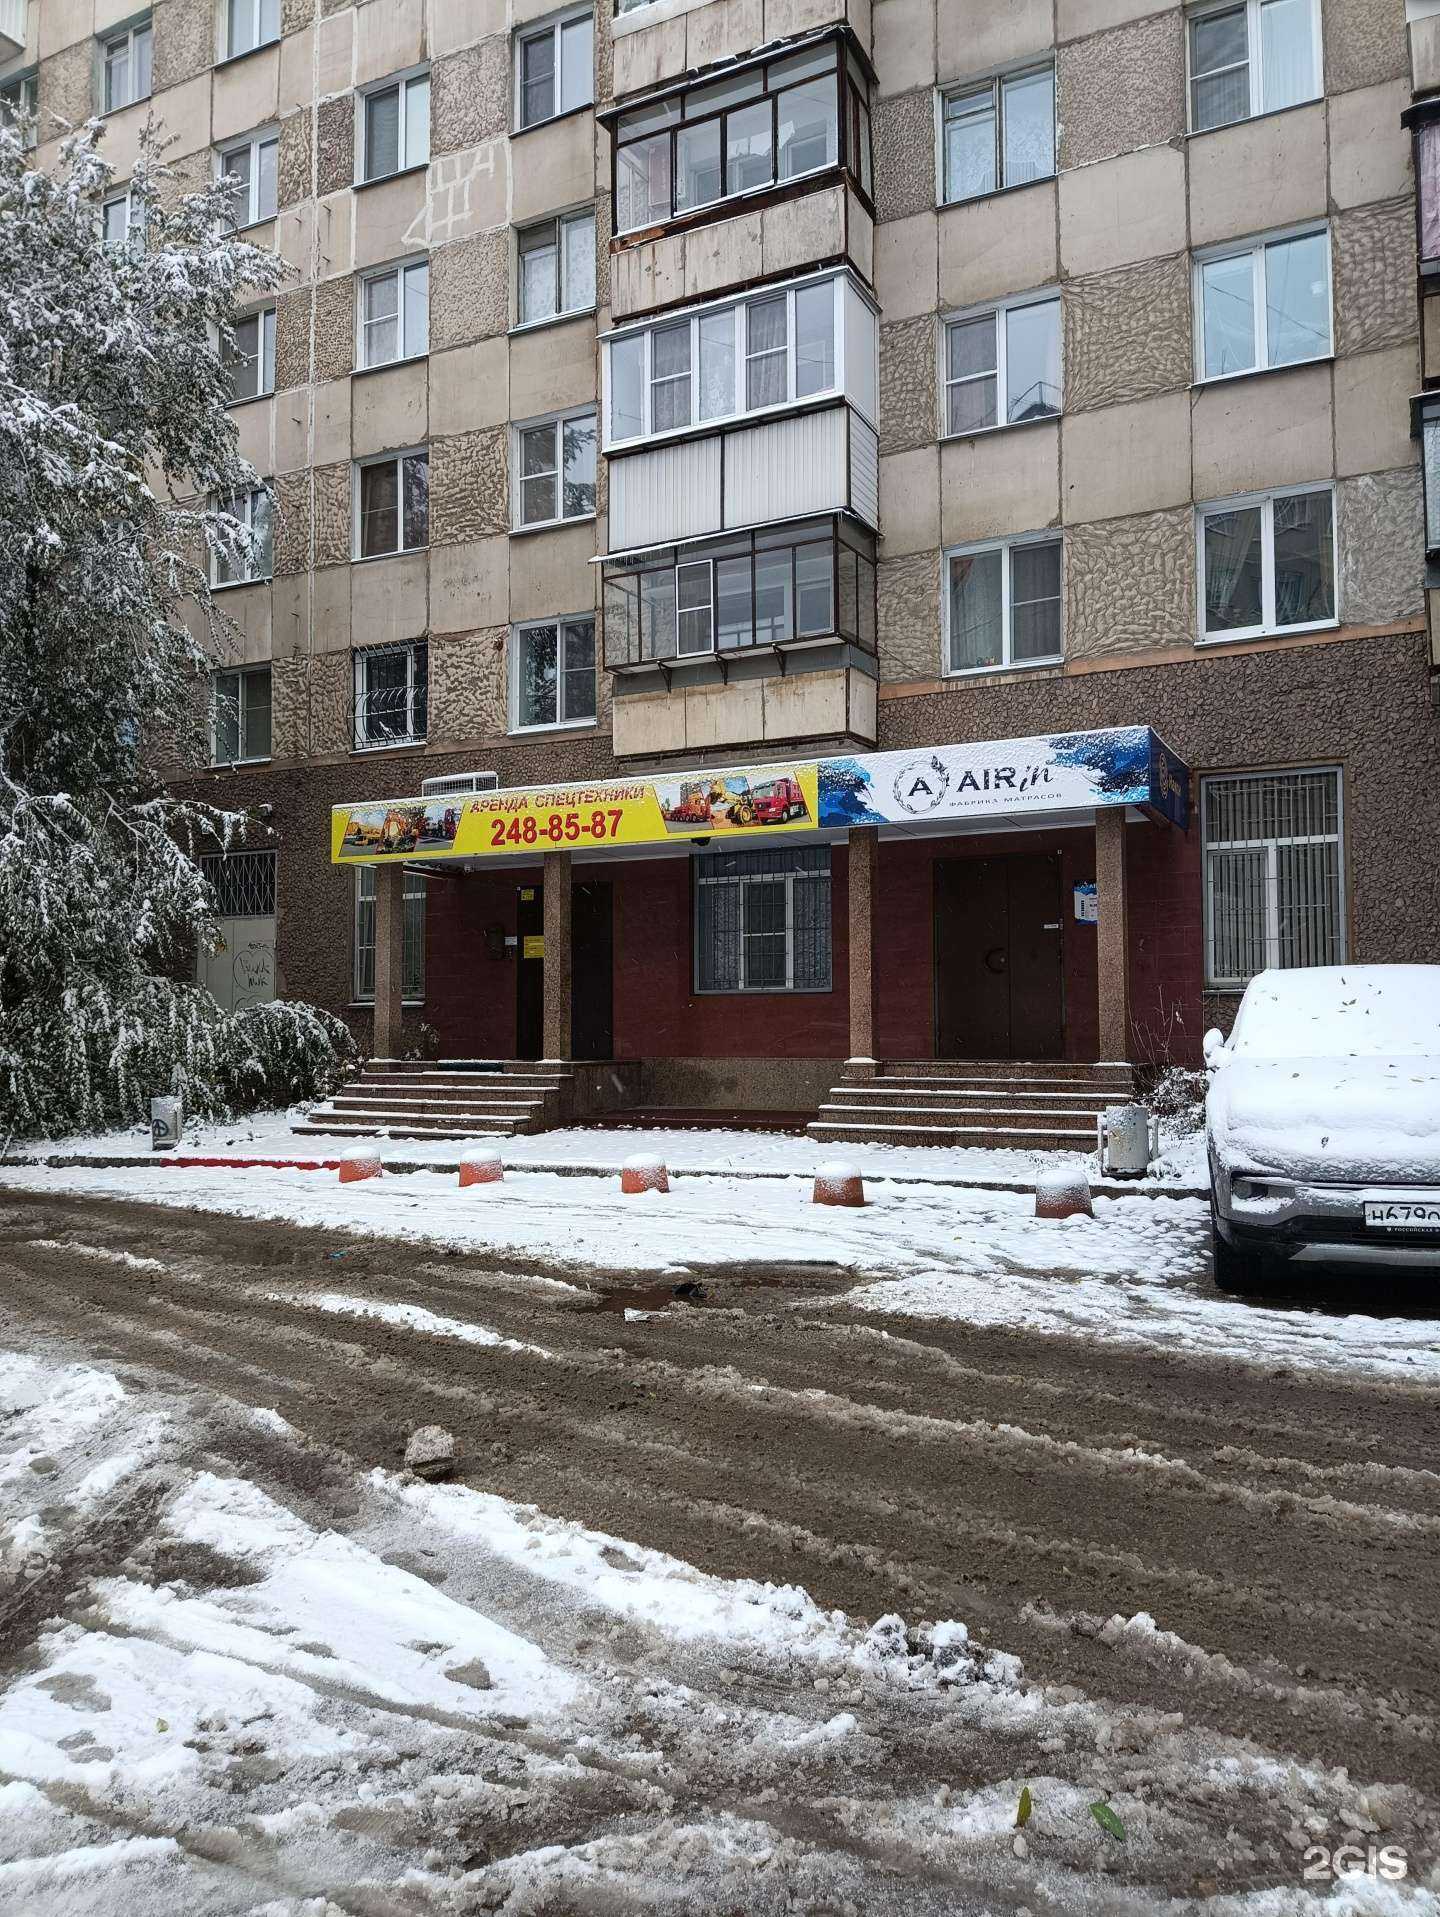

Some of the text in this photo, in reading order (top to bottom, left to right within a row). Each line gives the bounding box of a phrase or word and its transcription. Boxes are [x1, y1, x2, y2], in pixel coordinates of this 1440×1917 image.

[470, 785, 645, 814] АРЕНДА СПЕЦТЕХНИКИ
[948, 793, 1063, 807] ФАБРИКА МАТРАСОВ
[491, 808, 624, 846] 248-85-87
